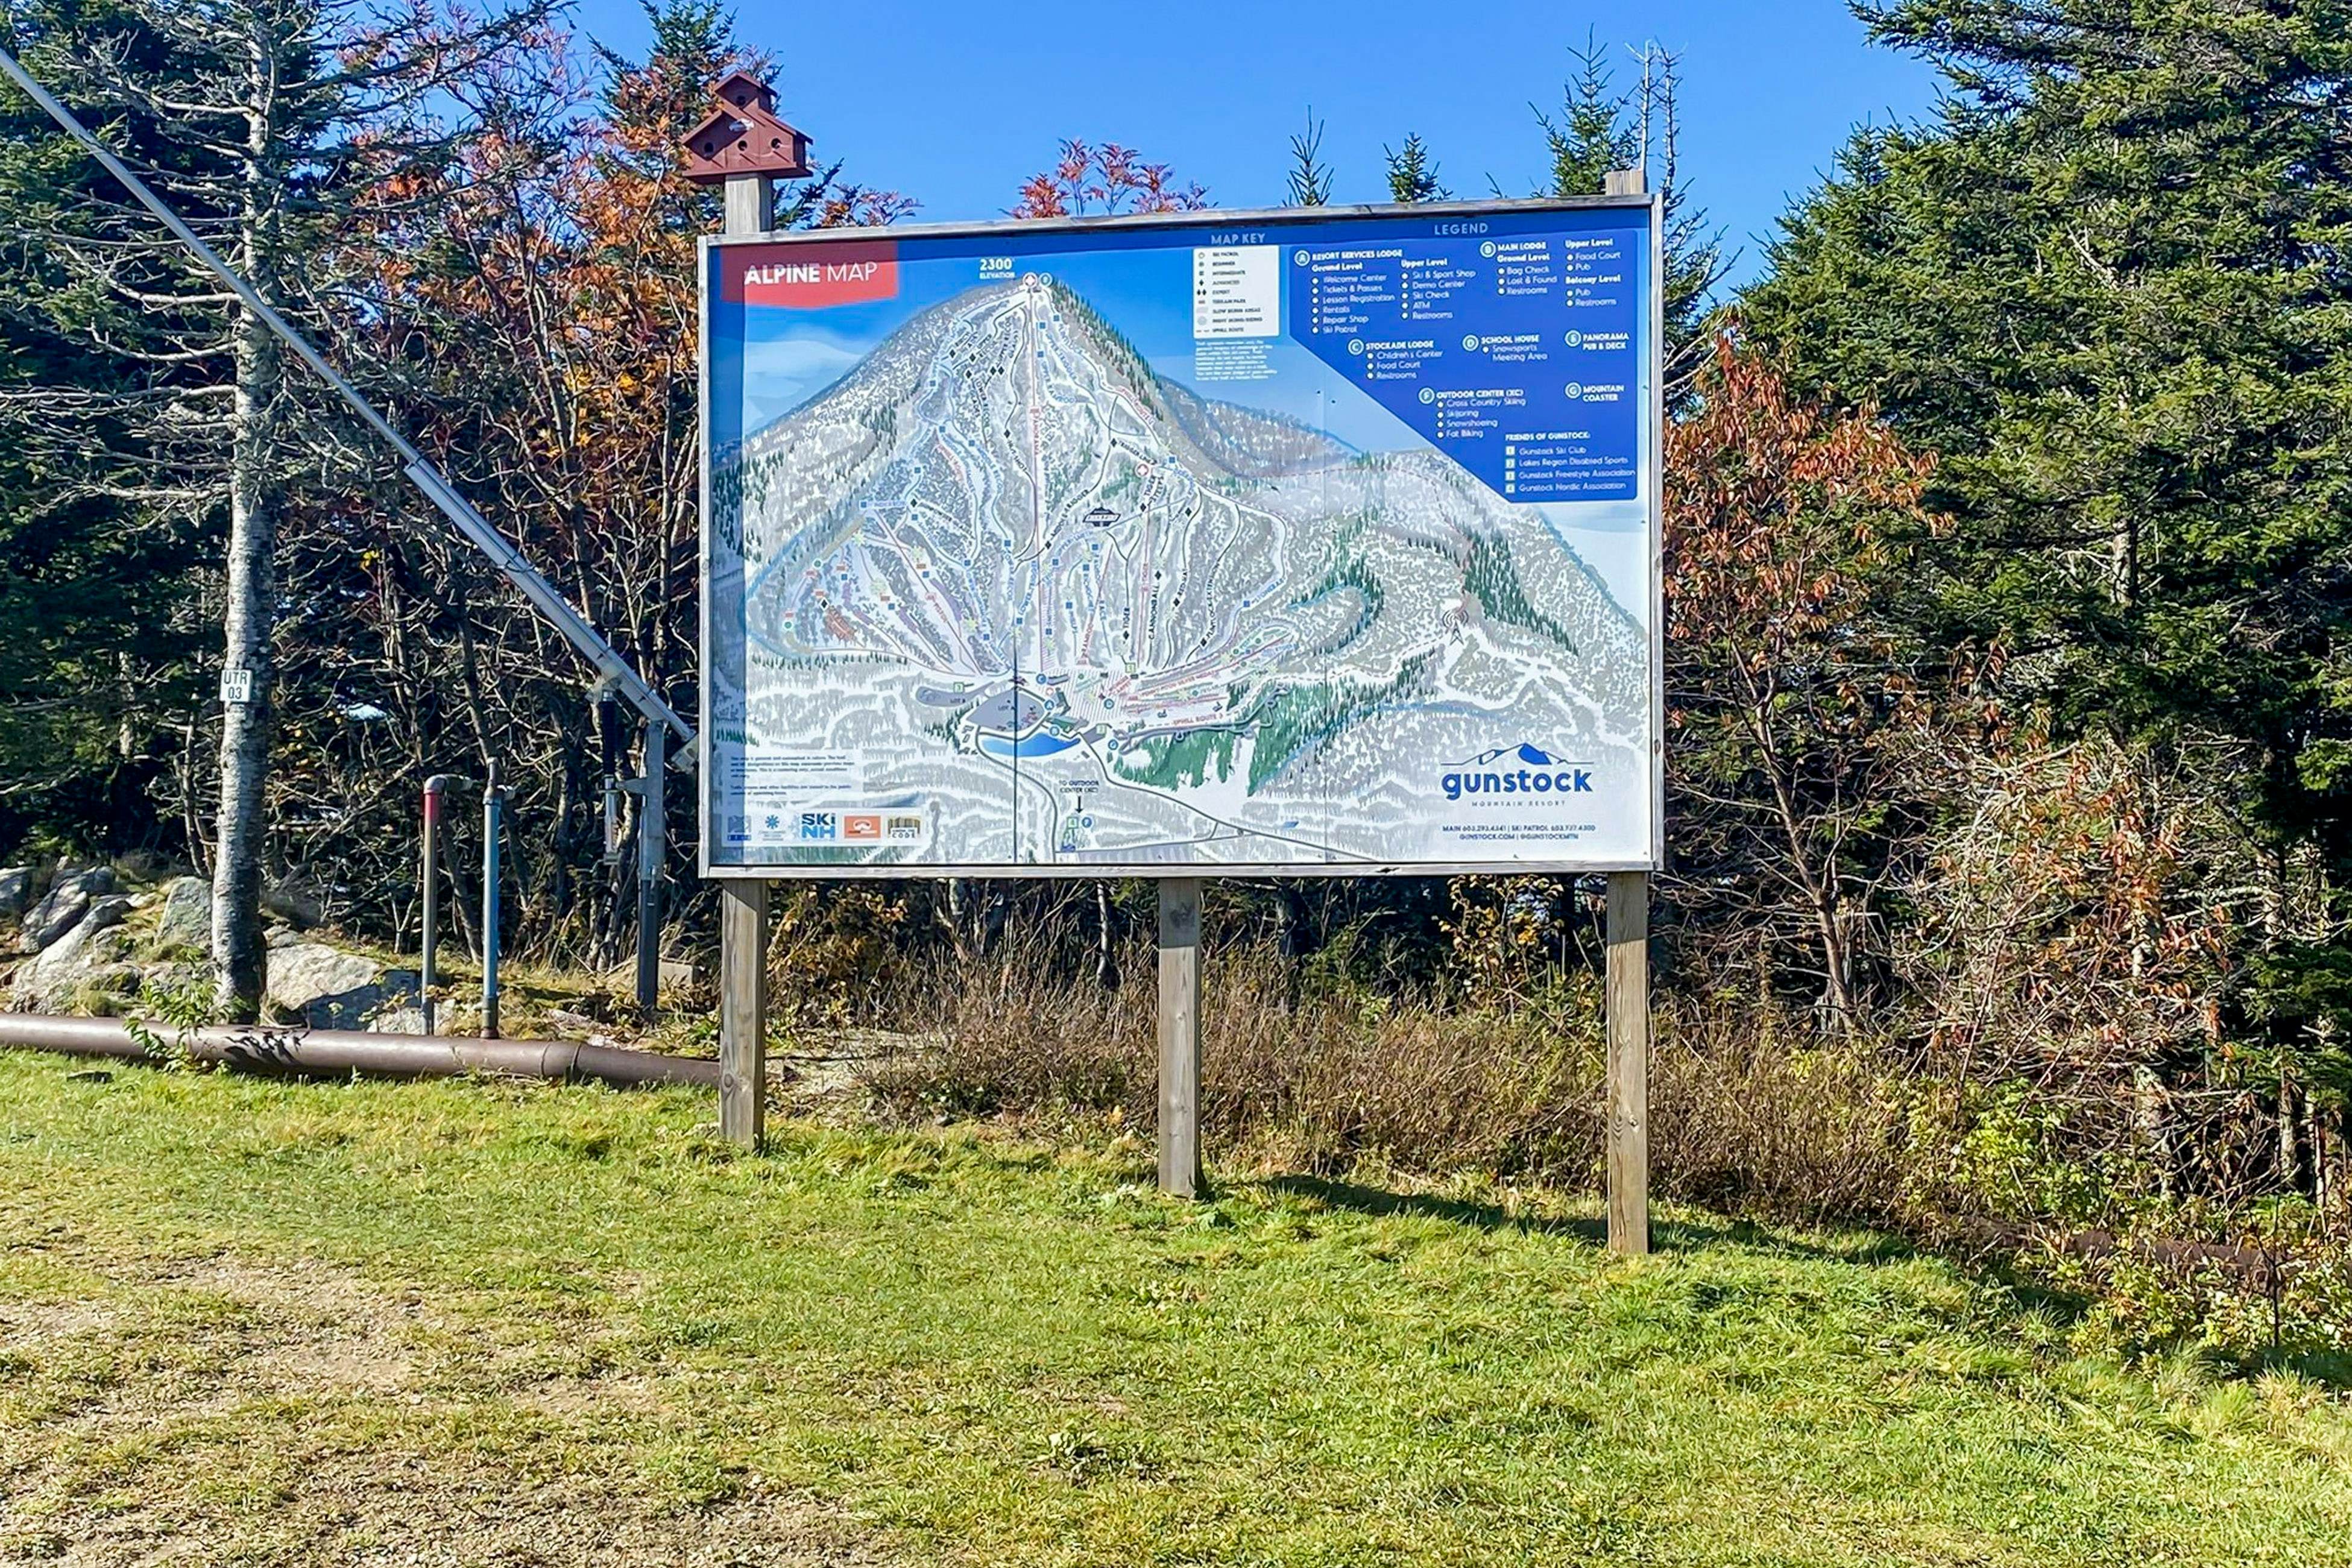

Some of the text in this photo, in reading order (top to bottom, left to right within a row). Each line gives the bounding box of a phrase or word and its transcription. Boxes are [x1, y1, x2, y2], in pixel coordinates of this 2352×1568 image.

[1435, 223, 1488, 235] LEGEND
[1211, 233, 1265, 245] MAP KEY
[1591, 239, 1613, 247] Level
[1498, 241, 1546, 251] MAIN LODGE
[1312, 249, 1403, 261] RESORT SERVICES LODGE
[1528, 253, 1550, 262] Level
[1598, 251, 1621, 259] Court
[1401, 258, 1447, 268] Upper Level
[744, 262, 878, 285] ALPINE MAP
[1412, 271, 1423, 279] Ski
[1433, 270, 1454, 280] Sport
[1456, 269, 1476, 278] Shop
[1507, 267, 1522, 276] Bag
[1438, 280, 1465, 288] Center
[1565, 274, 1621, 285] Balcony Level
[1507, 286, 1548, 295] Restrooms
[1350, 294, 1395, 303] Registration
[1413, 291, 1449, 300] Ski Check
[1575, 298, 1617, 307] Restrooms
[1323, 315, 1369, 324] Repair Shop
[1412, 311, 1453, 320] Restrooms
[1481, 334, 1540, 344] SCHOOL HOUSE
[1582, 332, 1629, 341] PANORAMA
[1366, 342, 1407, 350] STOCKADE
[1408, 340, 1434, 348] LODGE
[1492, 345, 1537, 353] Snowsports
[1416, 349, 1443, 358] Center
[1492, 352, 1548, 362] Meeting Area
[1398, 360, 1420, 368] Court
[1583, 385, 1625, 393] MOUNTAIN
[1436, 392, 1474, 400] OUTDOOR
[1447, 397, 1527, 408] Cross Country Skiing
[1447, 409, 1479, 418] Skijoring
[1447, 419, 1498, 428] Snowshoeing
[1461, 429, 1483, 438] Biking
[1542, 459, 1568, 467] Region
[1569, 457, 1603, 465] Disabled
[1555, 470, 1590, 479] Freestyle
[1592, 468, 1636, 477] Association
[1583, 482, 1626, 490] Association
[1149, 585, 1159, 640] CANNONBALL
[224, 672, 247, 684] UTR
[1442, 769, 1592, 800] gunstock
[802, 826, 836, 838] NH
